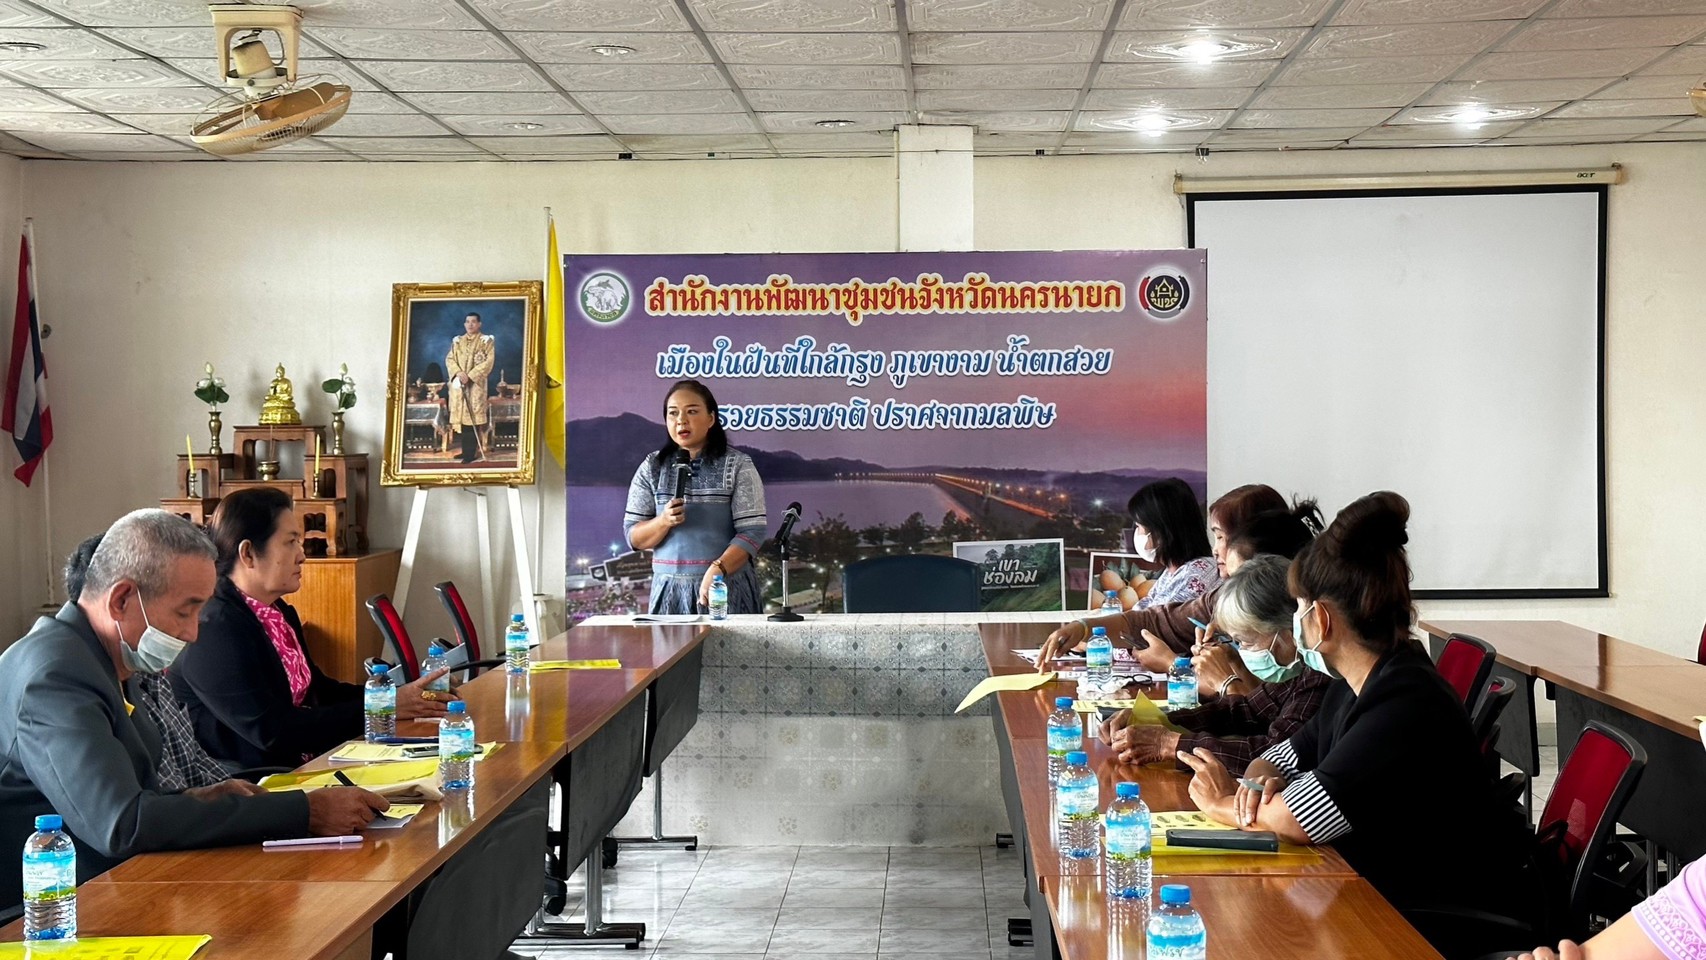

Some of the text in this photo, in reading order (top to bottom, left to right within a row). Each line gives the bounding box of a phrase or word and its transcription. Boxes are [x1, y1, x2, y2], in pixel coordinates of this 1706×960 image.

[648, 277, 1122, 322] สำนักงานพัฒนาชุมชนจังหวัดนครนายก
[657, 336, 1112, 387] เมืองในฝันที่ใกล้กรุง ภูเขางาม น้ำตกสวย
[717, 397, 1055, 429] รวยธรรมชาติ ปราศจากมลพิษ
[983, 566, 1038, 585] ช่องลม
[998, 558, 1021, 572] เขา
